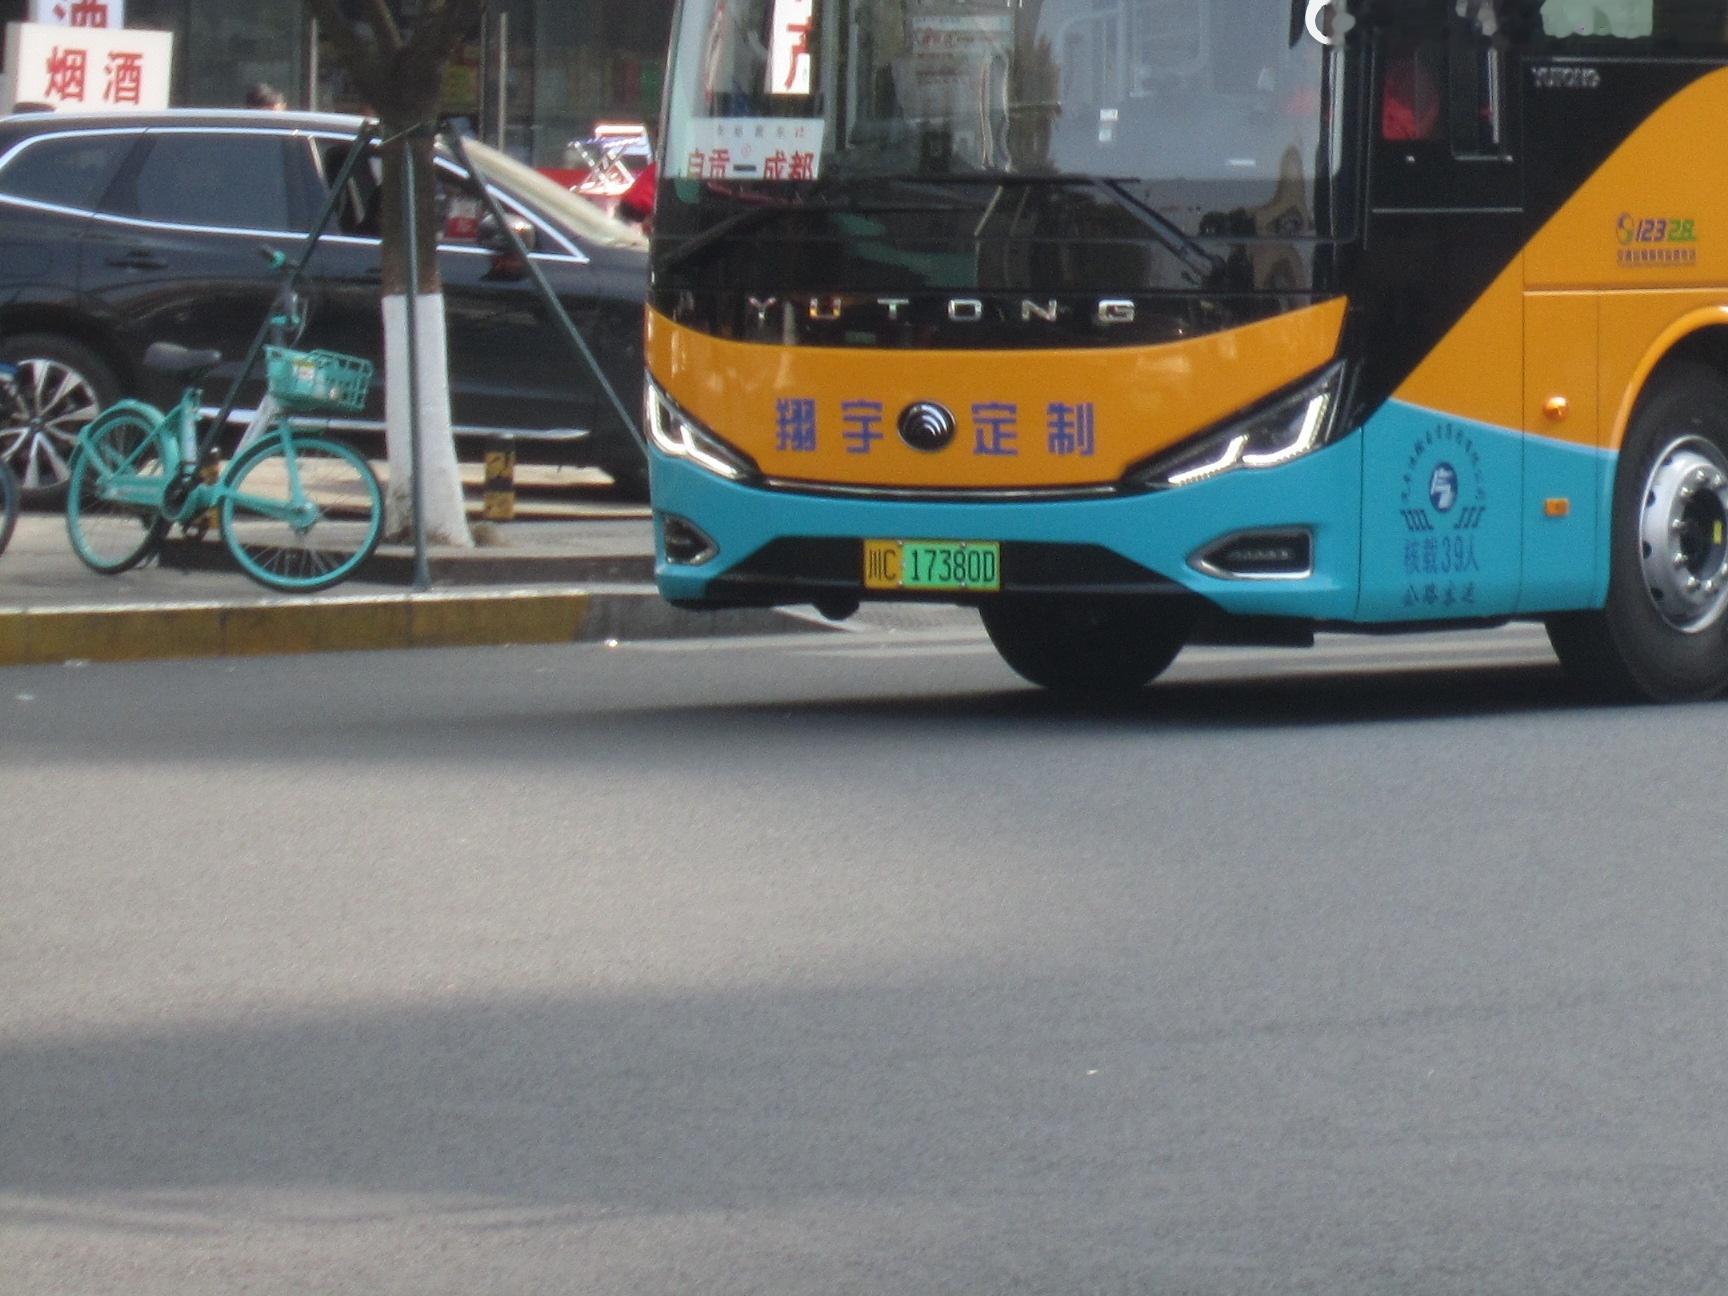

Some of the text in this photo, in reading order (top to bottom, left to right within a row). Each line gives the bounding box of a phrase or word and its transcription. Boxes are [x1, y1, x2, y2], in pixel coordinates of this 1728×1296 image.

[45, 47, 144, 104] 烟酒
[1635, 218, 1696, 242] 12328
[748, 297, 1136, 323] YUTONG
